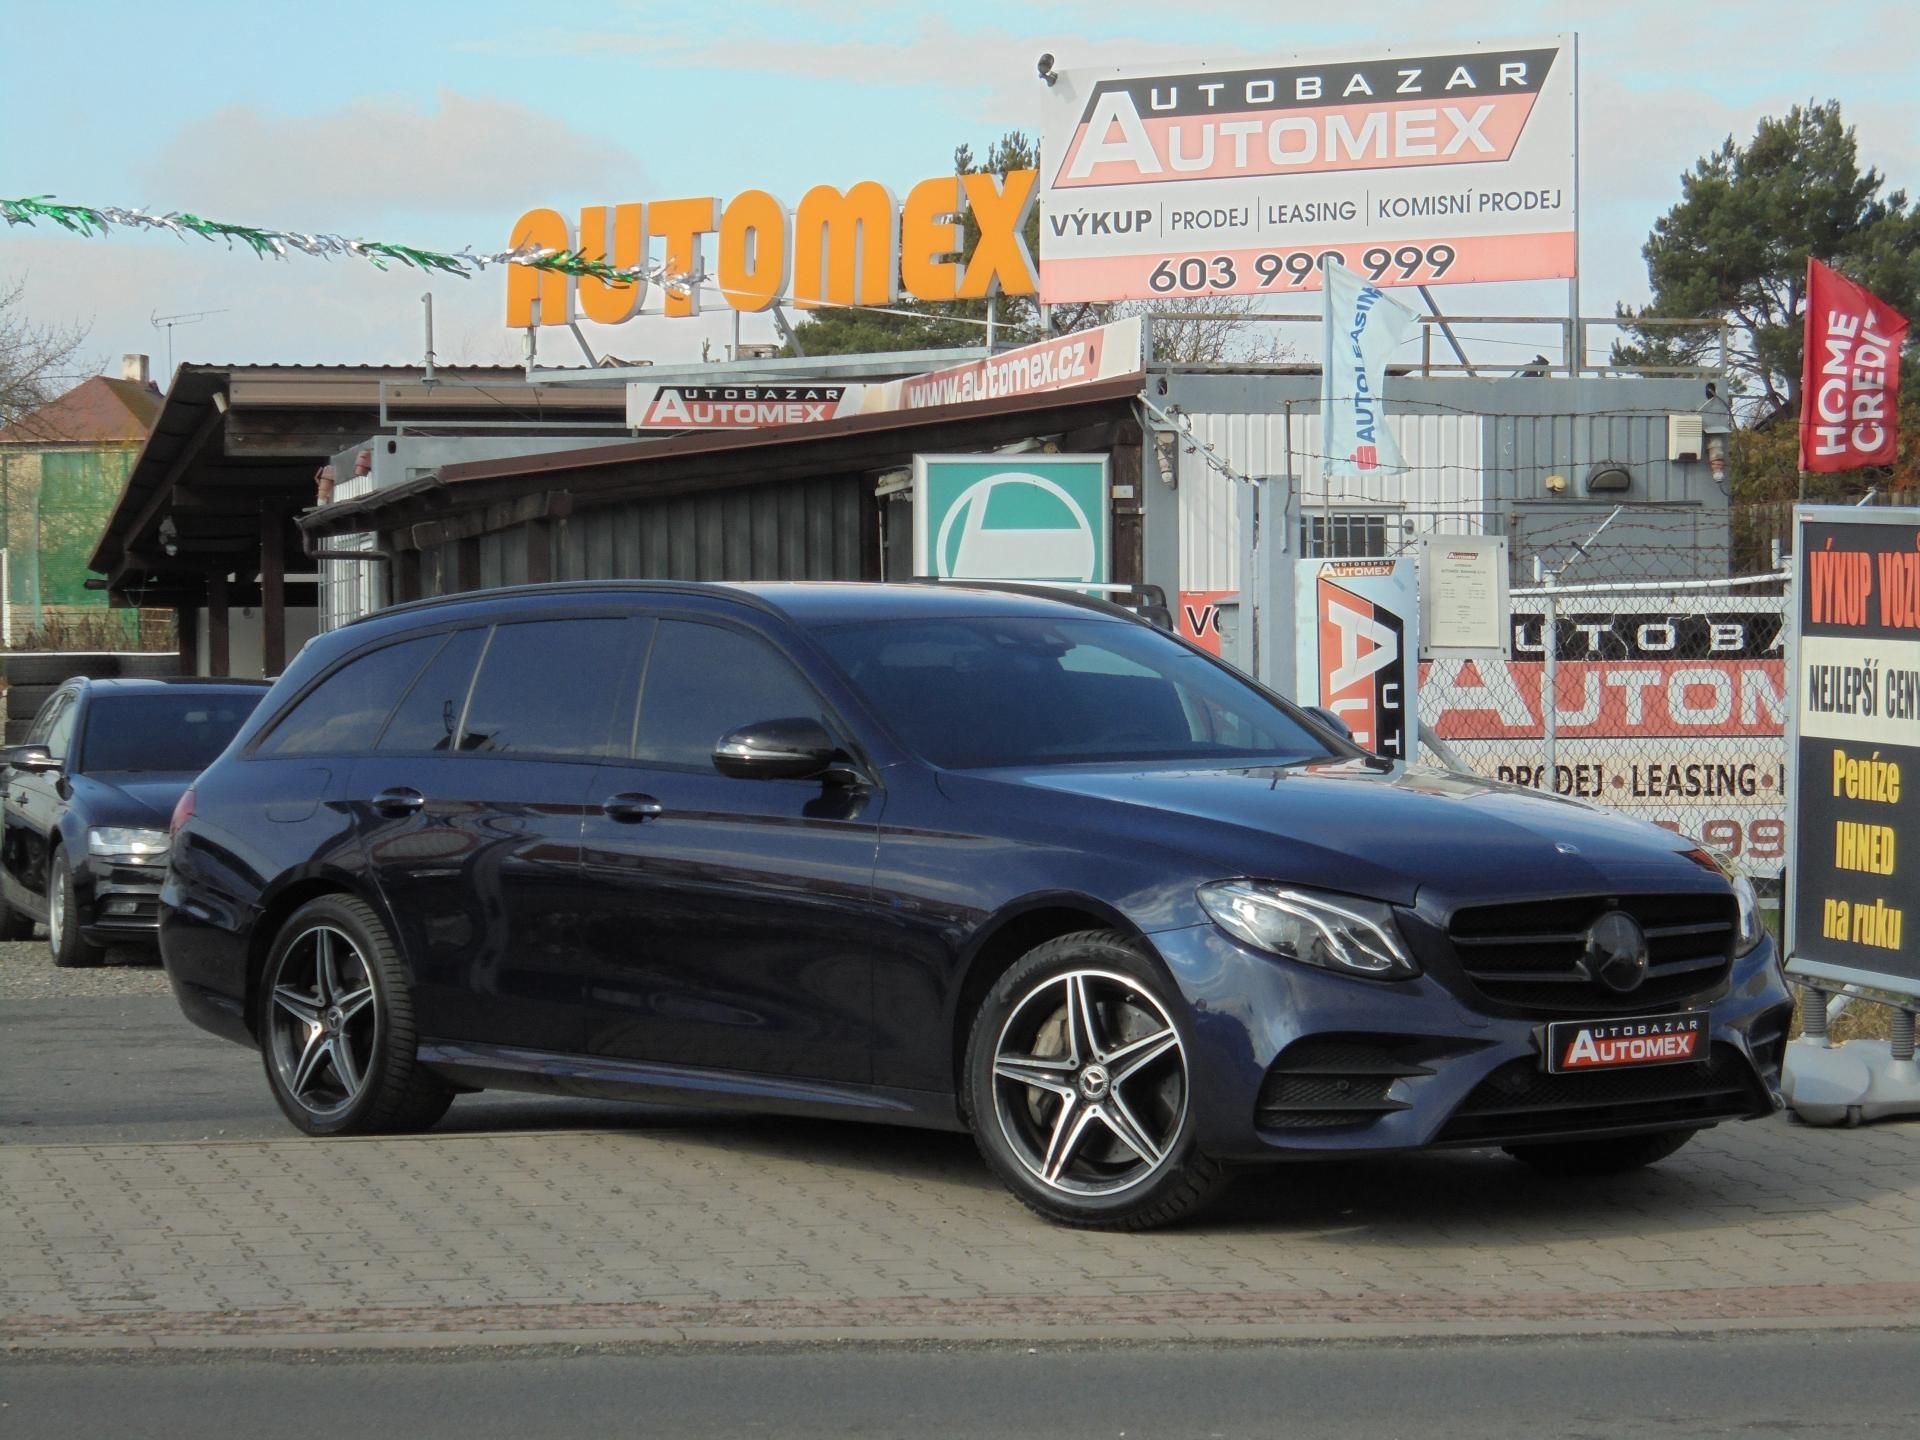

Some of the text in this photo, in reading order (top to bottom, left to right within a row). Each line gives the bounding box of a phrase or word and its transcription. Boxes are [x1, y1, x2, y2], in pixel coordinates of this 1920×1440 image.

[1067, 90, 1496, 179] AUTOMEX
[1050, 188, 1562, 237] VÝKUP PRODEJ LEASING KOMISNÍ PRODEJ
[507, 169, 1039, 329] AUTOMEX
[1148, 256, 1238, 293] 603
[1361, 243, 1457, 283] 999
[910, 341, 1085, 409] www.automex.cz
[1816, 310, 1859, 456] HOME
[1851, 307, 1891, 453] CREDIT
[650, 389, 826, 423] AUTOMEX
[1319, 562, 1390, 577] AUTOMEX
[1810, 537, 1872, 626] VÝKUP
[1809, 657, 1879, 717] NEJLEPŠÍ
[1631, 764, 1757, 798] LEASING
[1833, 749, 1901, 804] Peníze
[1835, 820, 1895, 876] IHNED
[1823, 898, 1902, 951] na ruku
[1568, 1029, 1691, 1064] AUTOMEX
